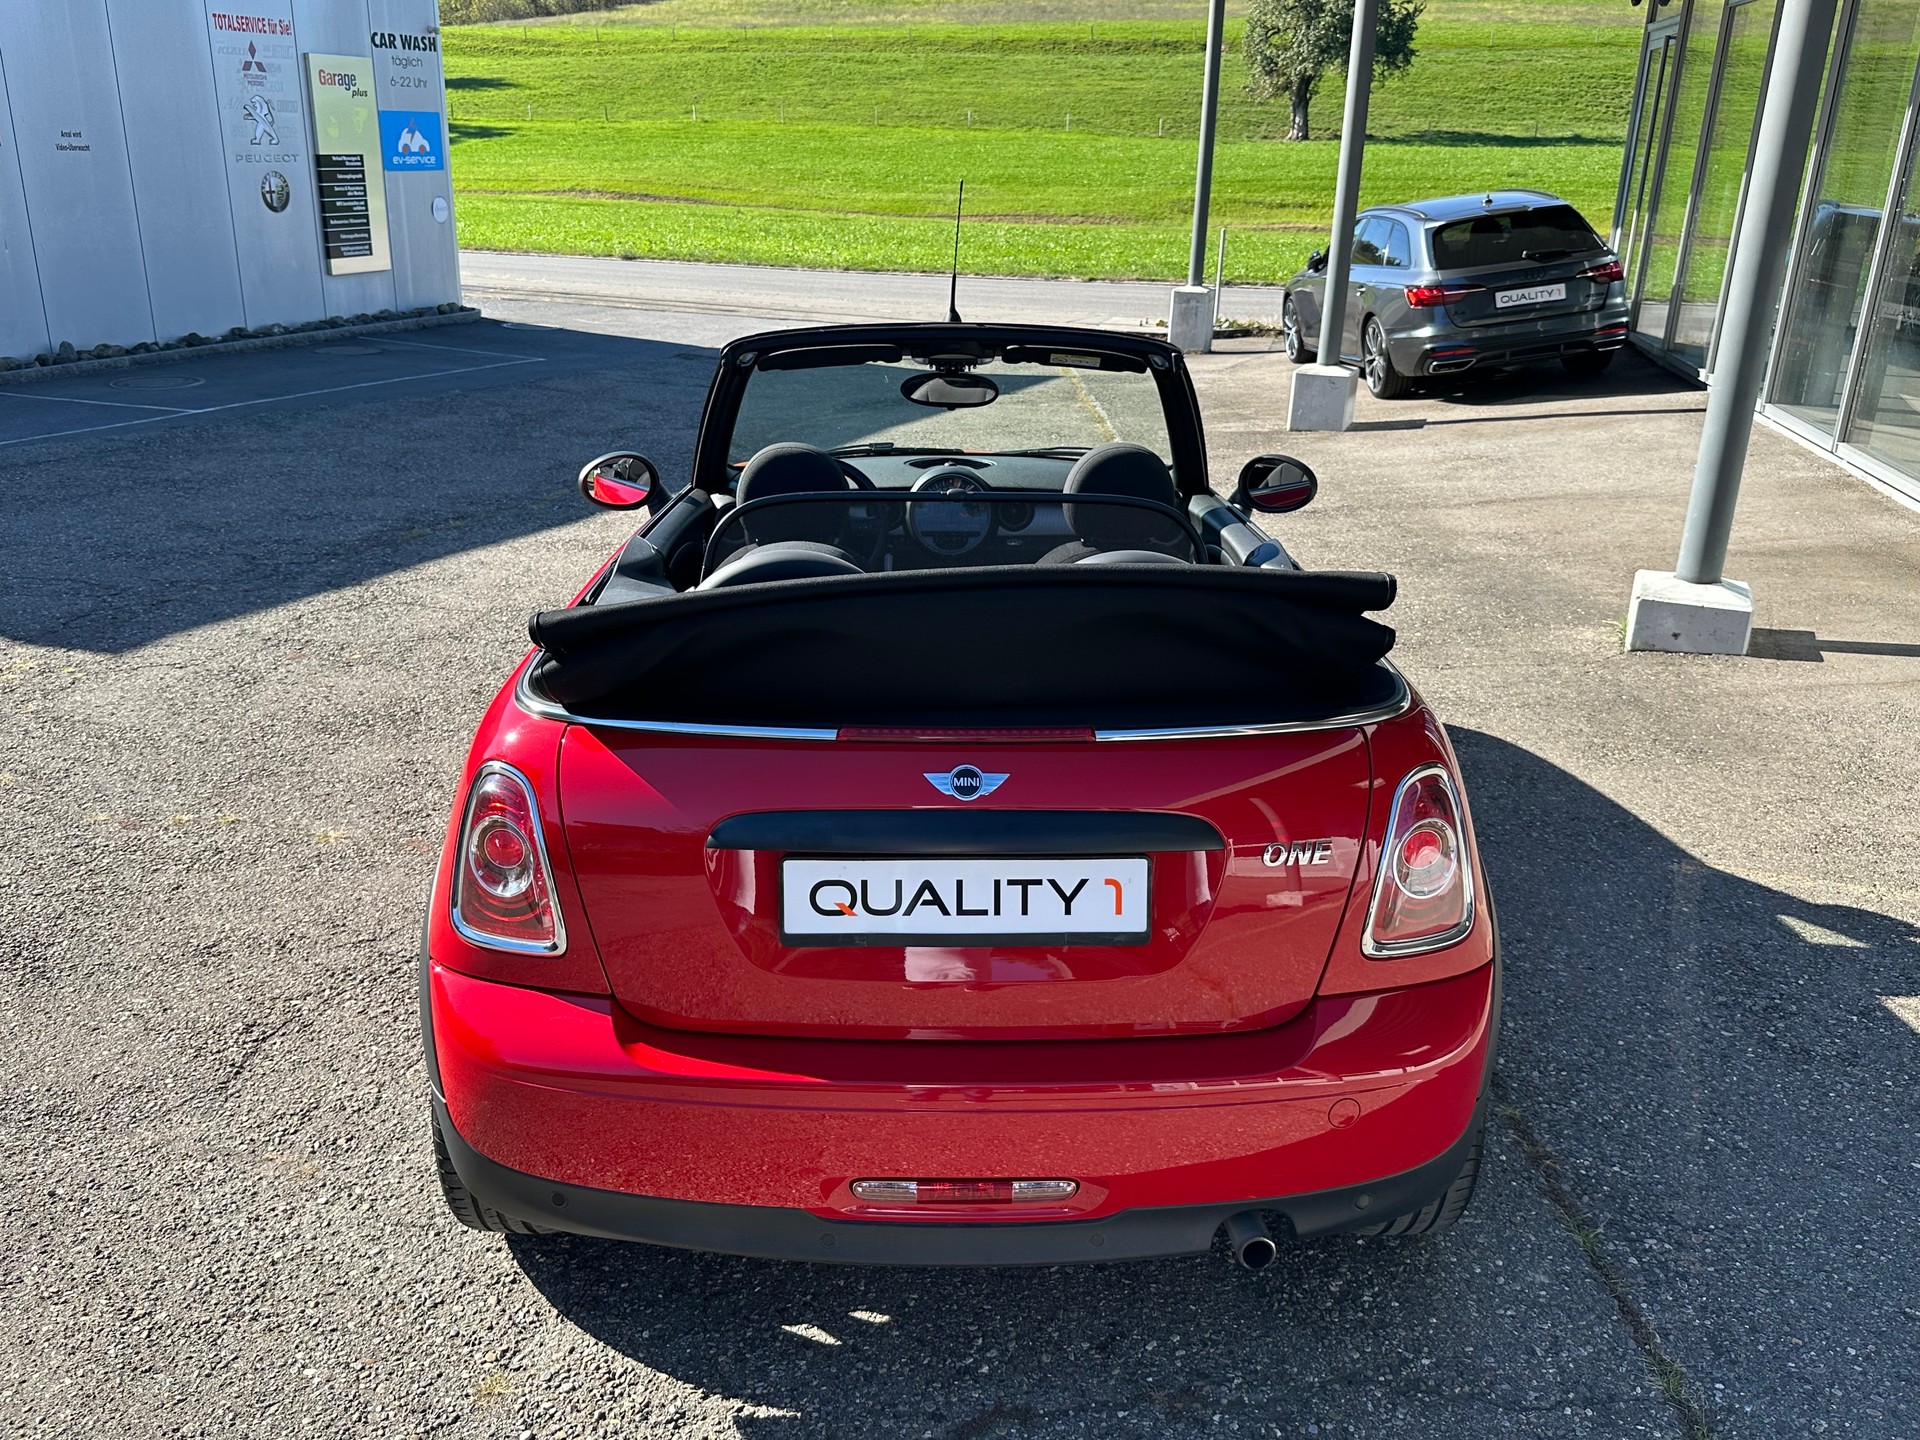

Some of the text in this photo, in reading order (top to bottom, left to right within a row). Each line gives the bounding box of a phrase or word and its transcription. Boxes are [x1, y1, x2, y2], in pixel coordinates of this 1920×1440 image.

[212, 13, 292, 36] TOTALSERVICE für Sie!
[371, 31, 437, 52] CAR WASH
[391, 55, 423, 69] täglich
[318, 68, 357, 91] Garage
[390, 76, 428, 89] 6-22 Uhr
[351, 88, 368, 98] plus
[235, 154, 299, 163] PEUGEOT
[392, 156, 436, 165] ev-service
[1500, 288, 1562, 304] QUALITY 1
[953, 777, 980, 787] MINI
[1262, 840, 1333, 867] ONE
[808, 877, 1124, 917] QUALITY 1
